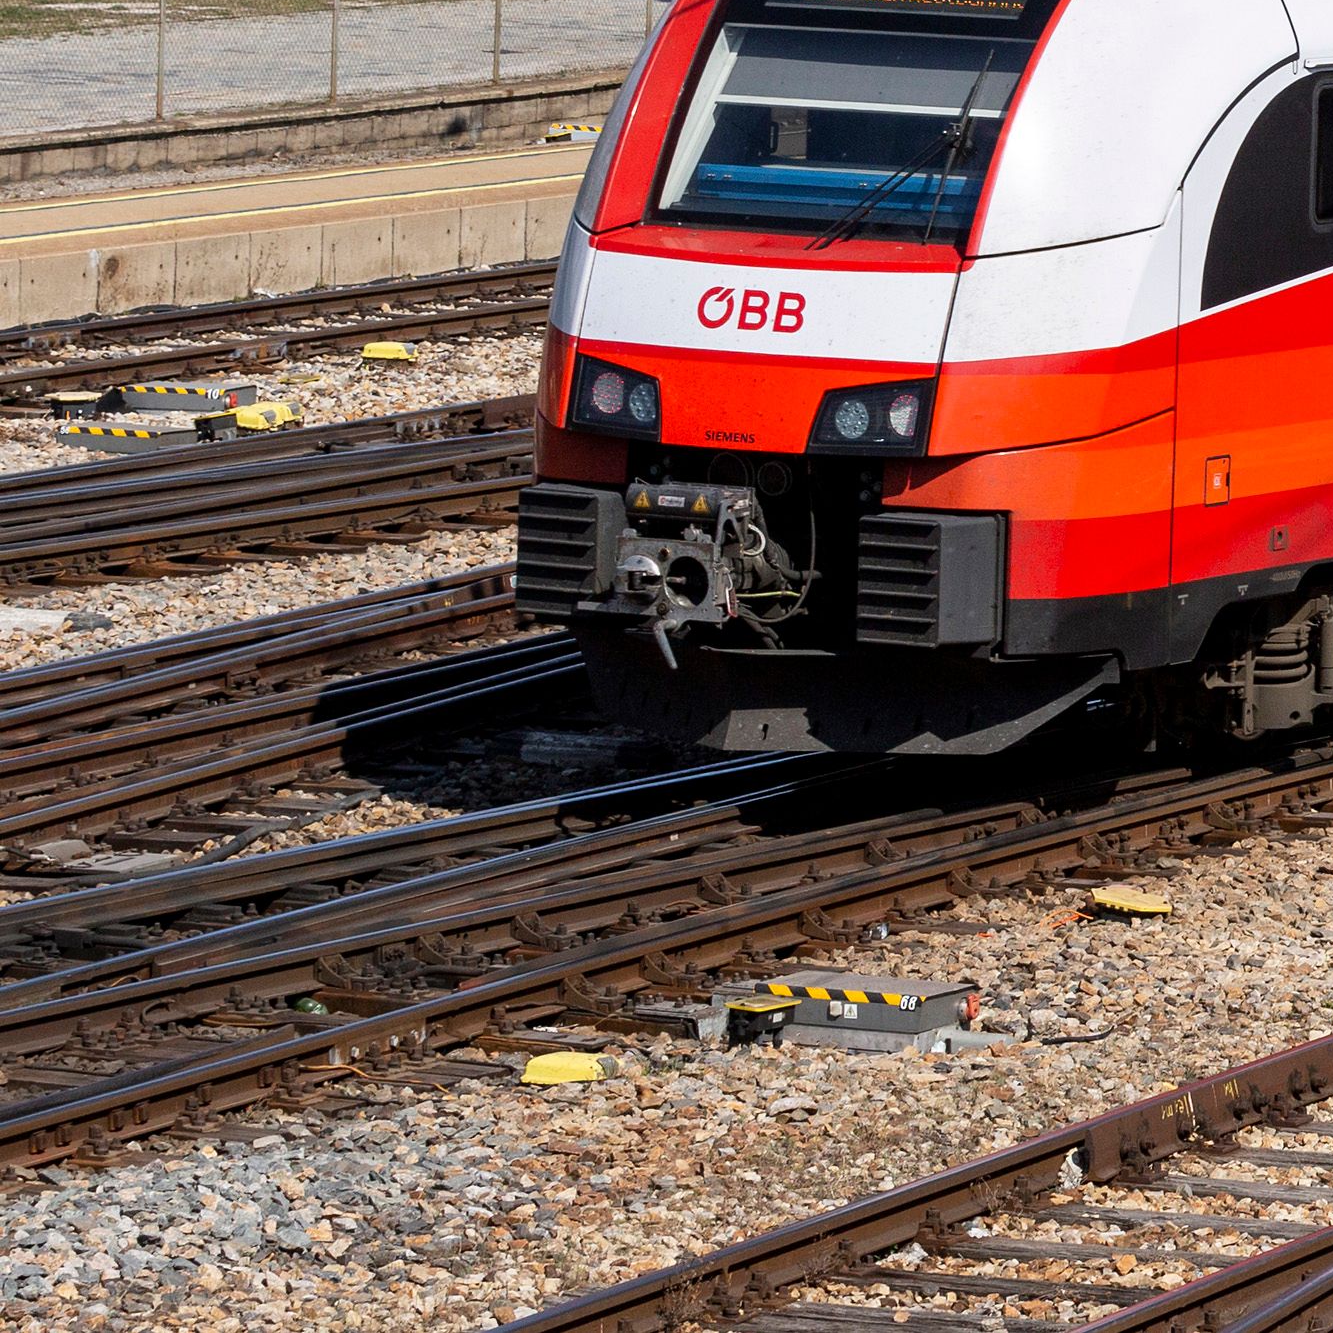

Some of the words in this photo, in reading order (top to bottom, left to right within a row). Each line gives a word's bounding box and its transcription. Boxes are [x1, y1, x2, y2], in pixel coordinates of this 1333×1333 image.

[697, 285, 806, 334] ÖBB
[206, 388, 220, 400] 10
[705, 430, 756, 444] SIEMENS
[900, 995, 918, 1011] 68
